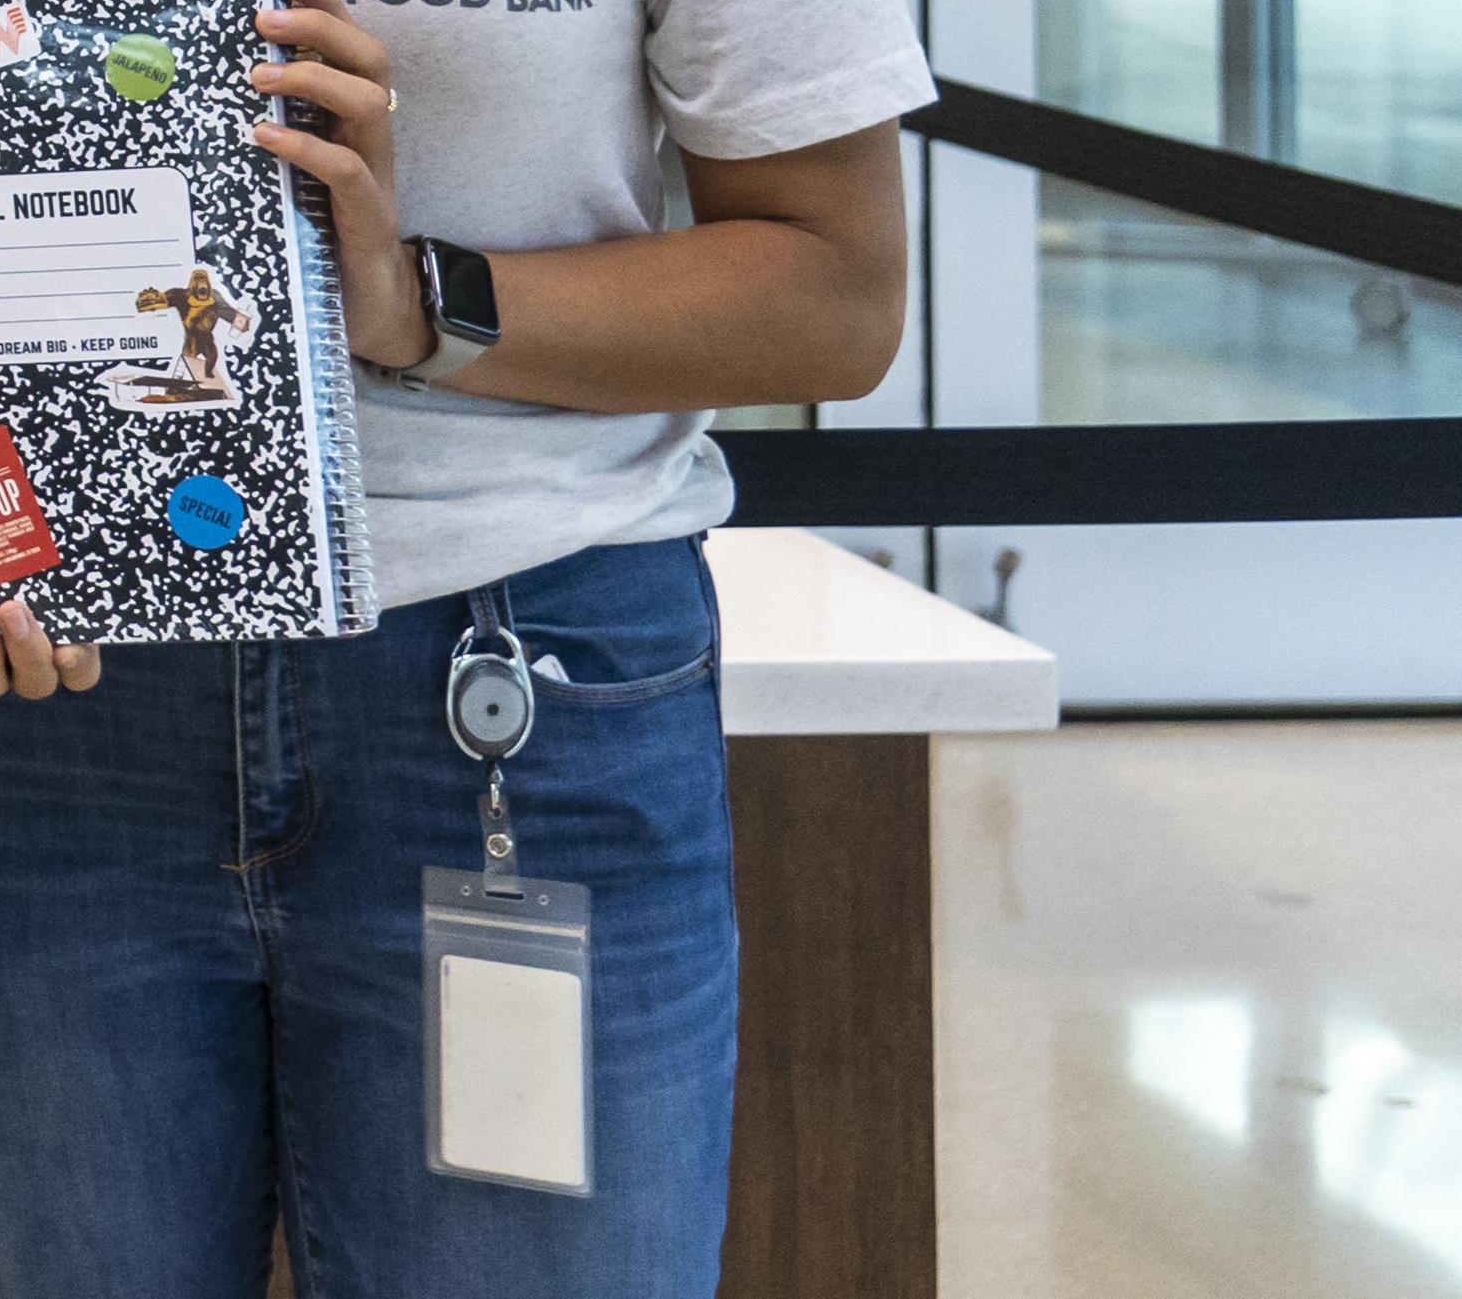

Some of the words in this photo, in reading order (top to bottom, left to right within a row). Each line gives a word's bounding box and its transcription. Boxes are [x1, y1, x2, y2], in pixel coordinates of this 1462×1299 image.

[13, 188, 138, 220] NOTEBOOK
[47, 339, 68, 354] BIG
[81, 338, 115, 352] KEEP
[120, 336, 158, 350] GOING
[178, 495, 232, 529] SPECIAL
